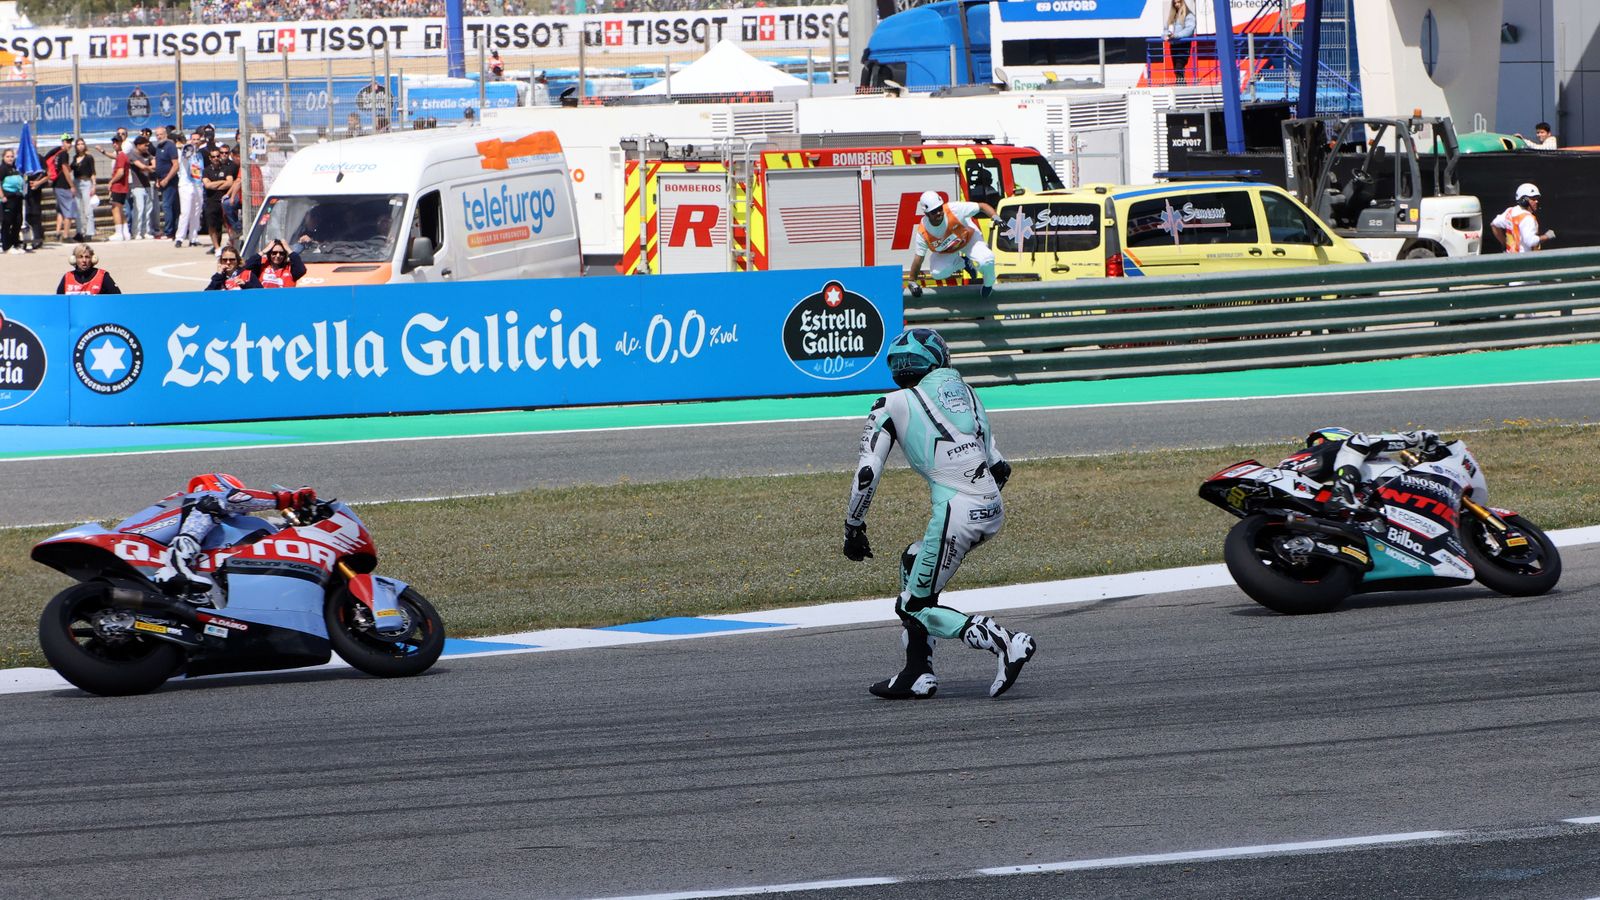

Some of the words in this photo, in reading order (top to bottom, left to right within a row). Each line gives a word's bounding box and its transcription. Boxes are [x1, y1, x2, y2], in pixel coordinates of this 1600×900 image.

[1052, 0, 1097, 12] OXFORD
[132, 31, 241, 56] TISSOT
[301, 25, 408, 51] TISSOT
[467, 22, 568, 49] TISSOT
[627, 17, 728, 45] TISSOT
[831, 151, 893, 166] BOMBEROS
[664, 183, 722, 193] BOMBEROS
[463, 184, 556, 234] telefurgo
[668, 204, 720, 248] R
[800, 308, 867, 332] Estrella
[162, 319, 389, 387] Estrella
[401, 308, 602, 377] Galicia
[645, 309, 706, 364] 0,0
[802, 331, 864, 354] Galicia
[823, 354, 844, 374] 0,0
